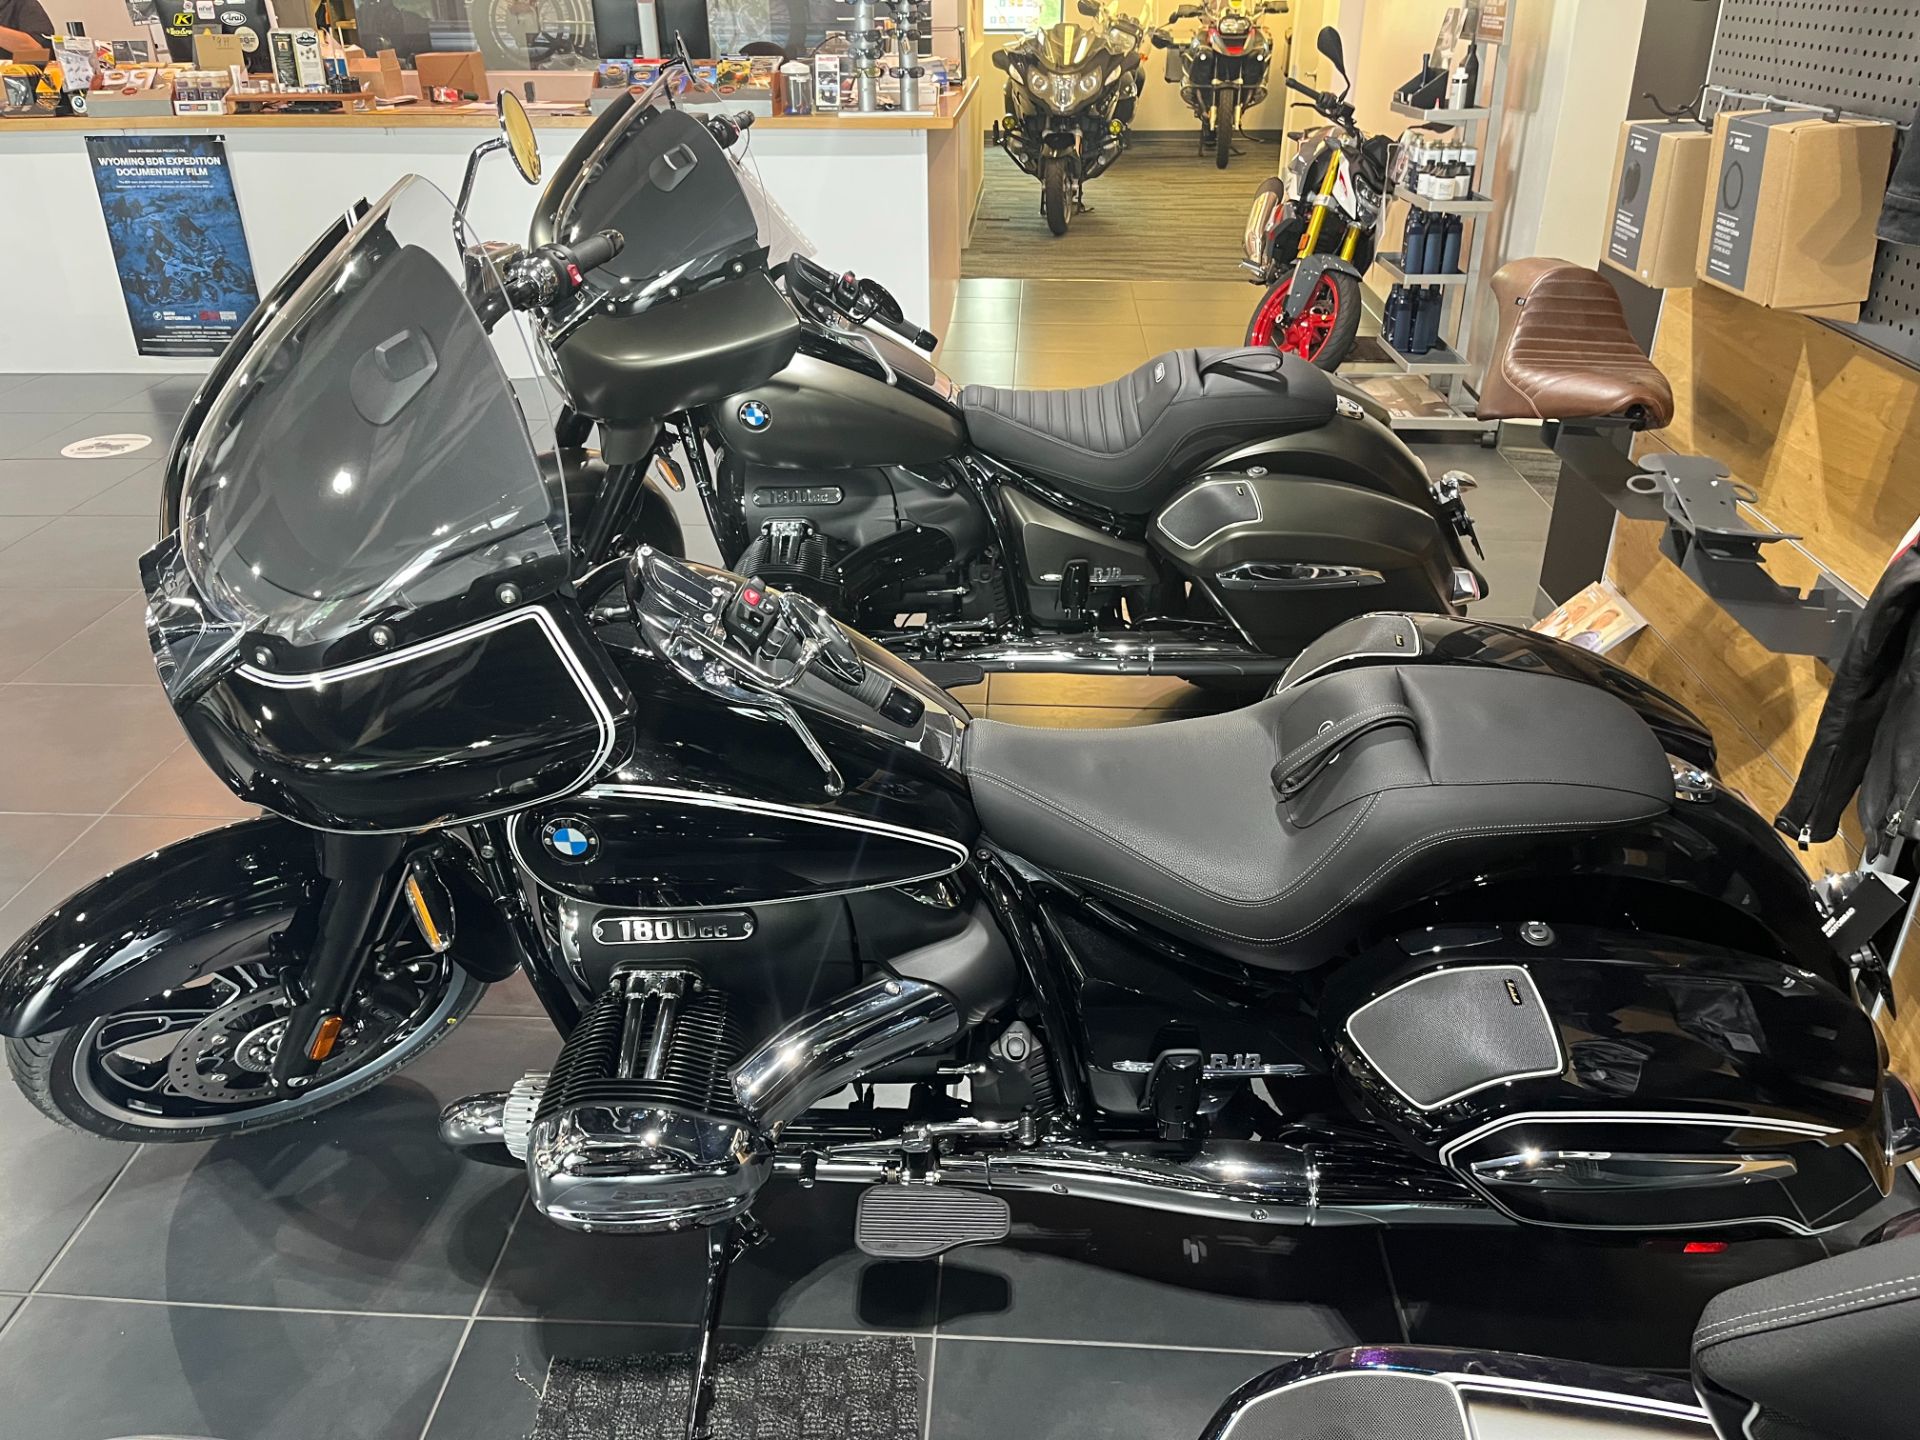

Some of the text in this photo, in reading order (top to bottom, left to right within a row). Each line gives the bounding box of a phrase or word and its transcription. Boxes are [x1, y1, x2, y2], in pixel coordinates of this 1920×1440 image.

[98, 156, 221, 166] WYOMING BDR EXPEDITION
[116, 168, 208, 176] DOCUMENTARY FILM
